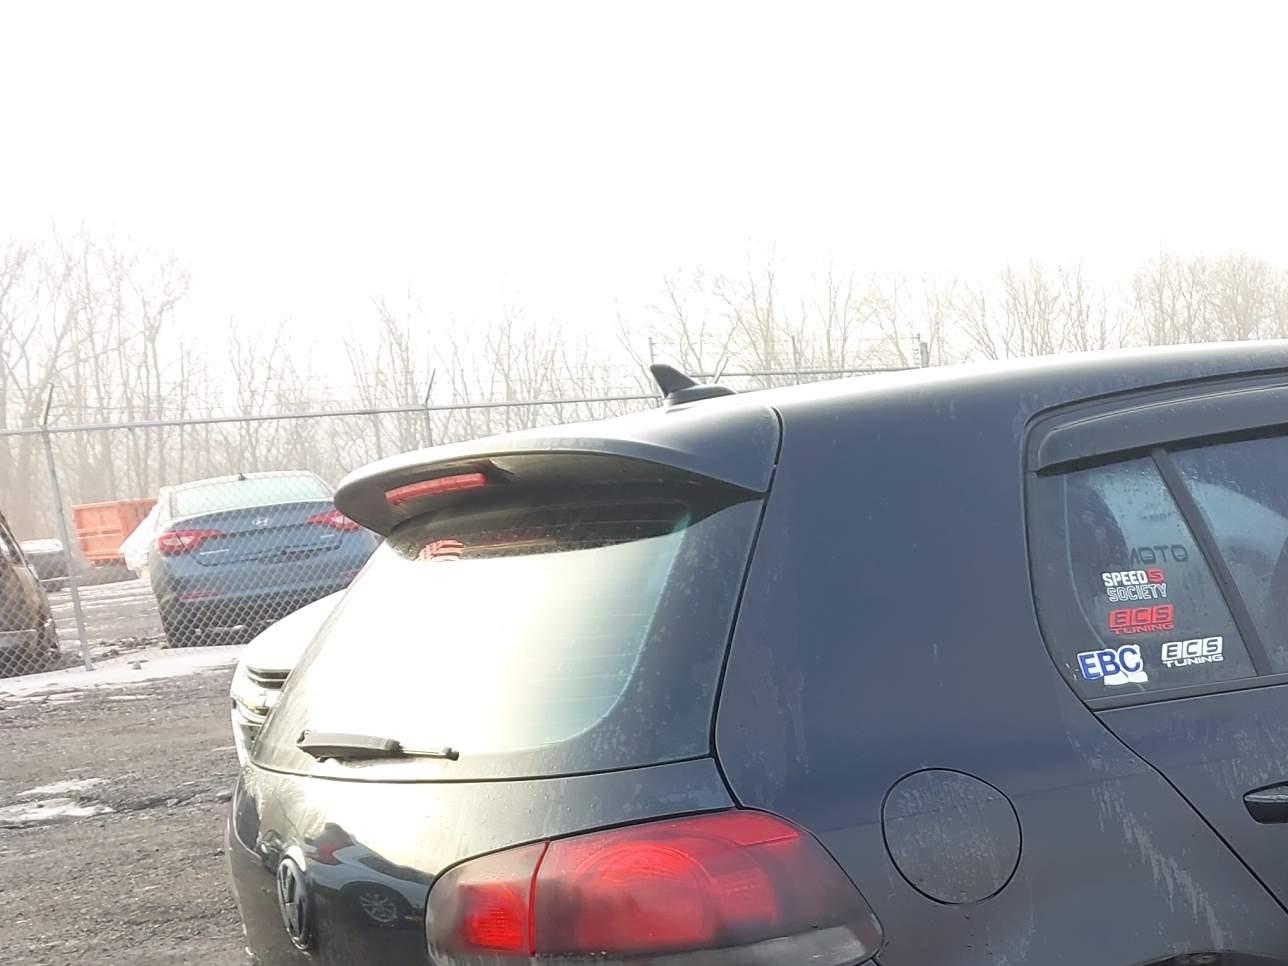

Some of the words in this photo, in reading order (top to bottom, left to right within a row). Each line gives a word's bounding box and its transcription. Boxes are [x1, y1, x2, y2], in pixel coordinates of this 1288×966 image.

[1102, 571, 1148, 587] SPEED
[1106, 583, 1167, 602] SOCIETY
[1110, 605, 1172, 627] ECS
[1110, 622, 1174, 635] TUNING
[1163, 638, 1222, 660] ECS
[1079, 646, 1141, 680] EBC
[1162, 654, 1223, 668] TUNING
